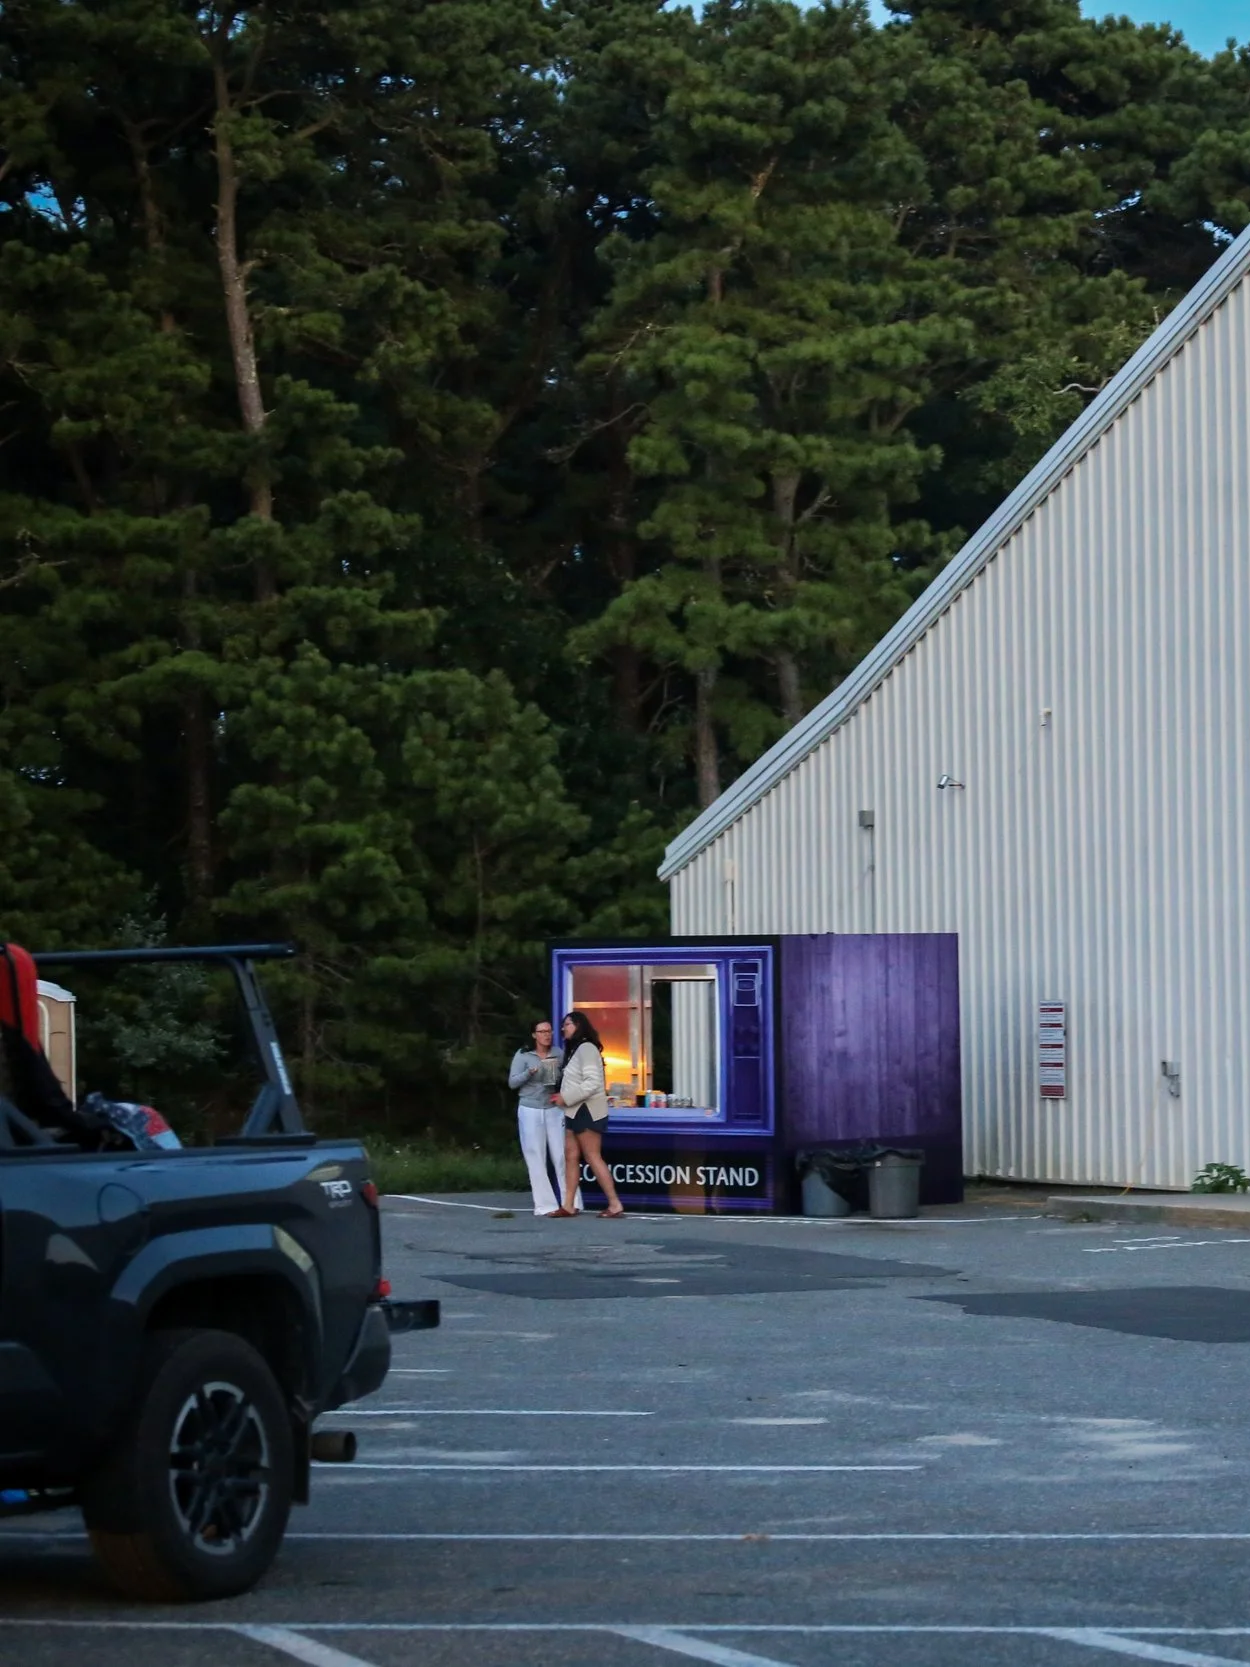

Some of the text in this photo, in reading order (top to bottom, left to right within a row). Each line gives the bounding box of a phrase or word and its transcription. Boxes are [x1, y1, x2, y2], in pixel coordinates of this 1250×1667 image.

[579, 1164, 759, 1187] OCESSION STAND
[320, 1180, 352, 1198] TRD
